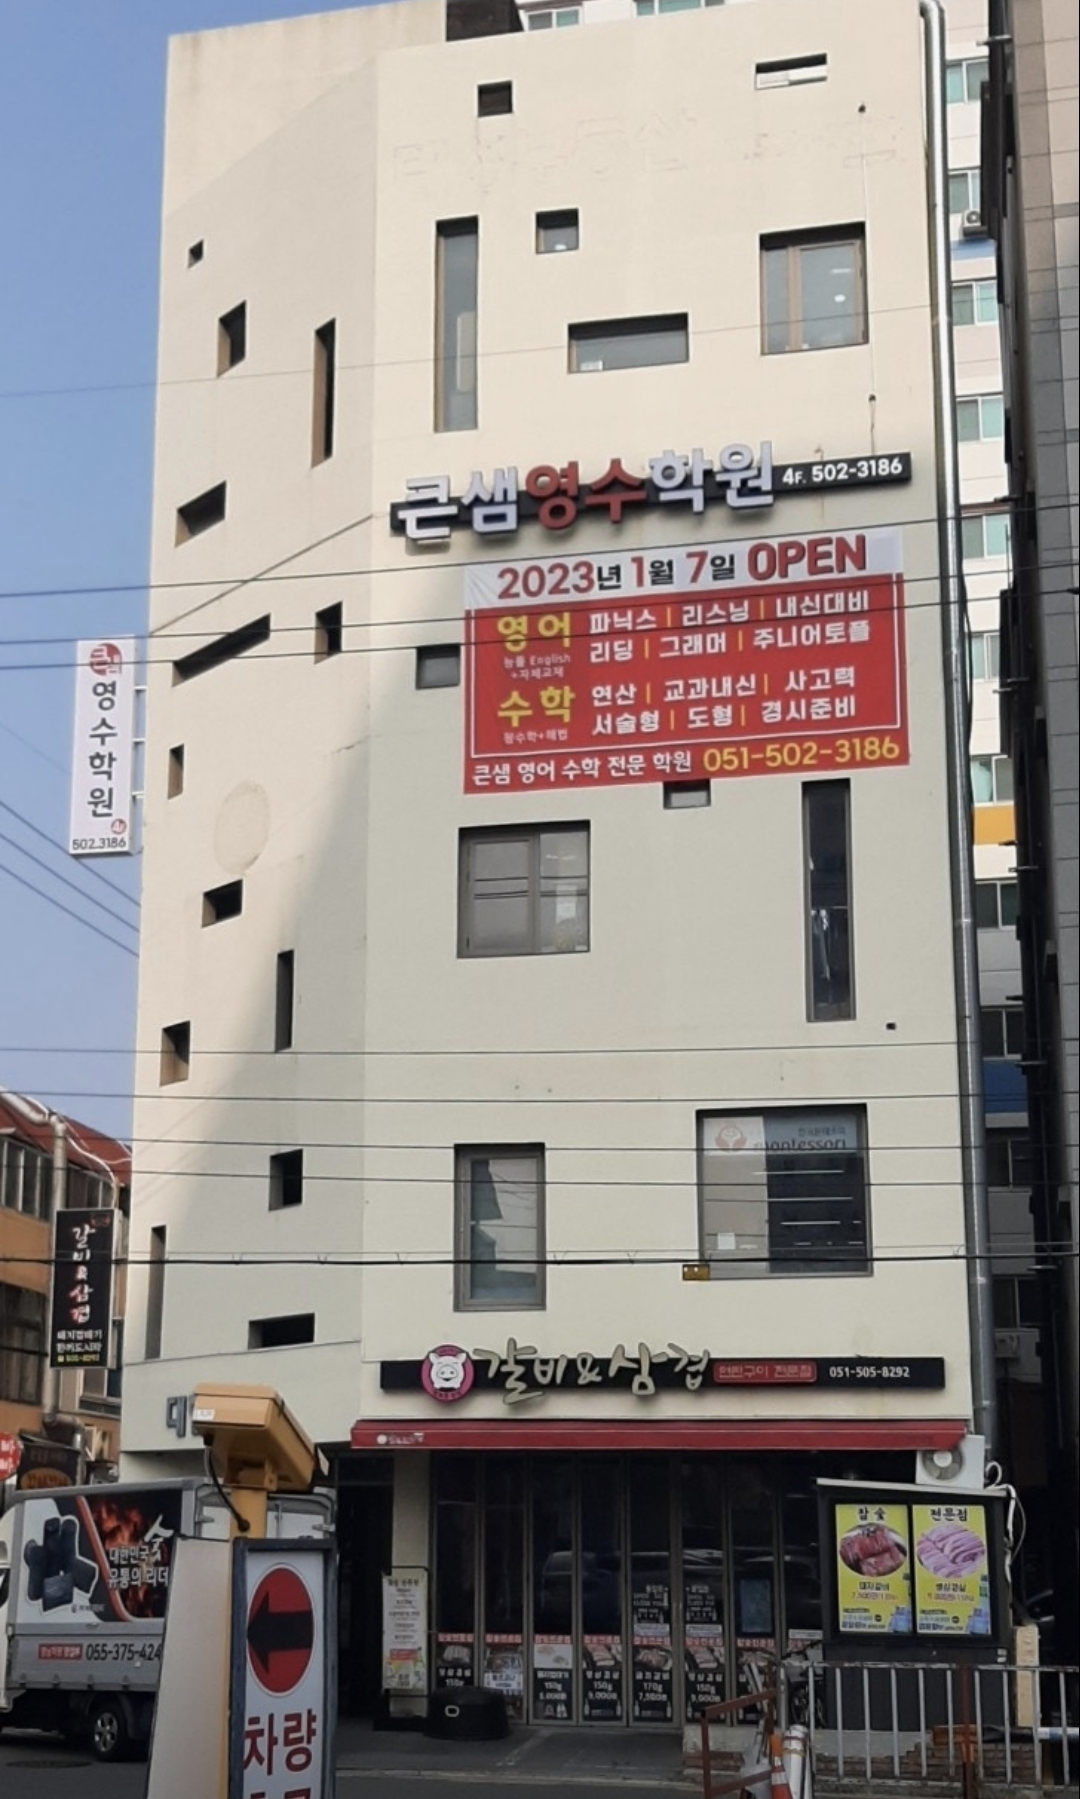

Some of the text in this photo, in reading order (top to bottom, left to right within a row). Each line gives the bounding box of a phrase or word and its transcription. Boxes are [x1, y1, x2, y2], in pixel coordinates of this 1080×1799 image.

[397, 441, 774, 542] 큰샘영수학원
[811, 458, 903, 483] 502-3186
[497, 534, 867, 599] 2023년 1월 7일 OPEN
[497, 612, 571, 652] 영어
[589, 590, 869, 635] 파닉스 리스닝 내신대비
[529, 653, 571, 667] English
[589, 620, 870, 663] 리딩 그래머 주니어토플
[497, 685, 575, 728] 수학
[591, 665, 856, 707] 연산 교과내신 사고력
[591, 695, 856, 736] 서술형 도형 경시준비
[87, 680, 118, 818] 영수학원
[472, 736, 900, 787] 큰샘 영어 수학 전문 학원 051-502-3186
[829, 1366, 911, 1379] 051-505-8292
[109, 1546, 150, 1565] 대한민국
[146, 1566, 169, 1587] 리더
[241, 1708, 317, 1777] 차량
